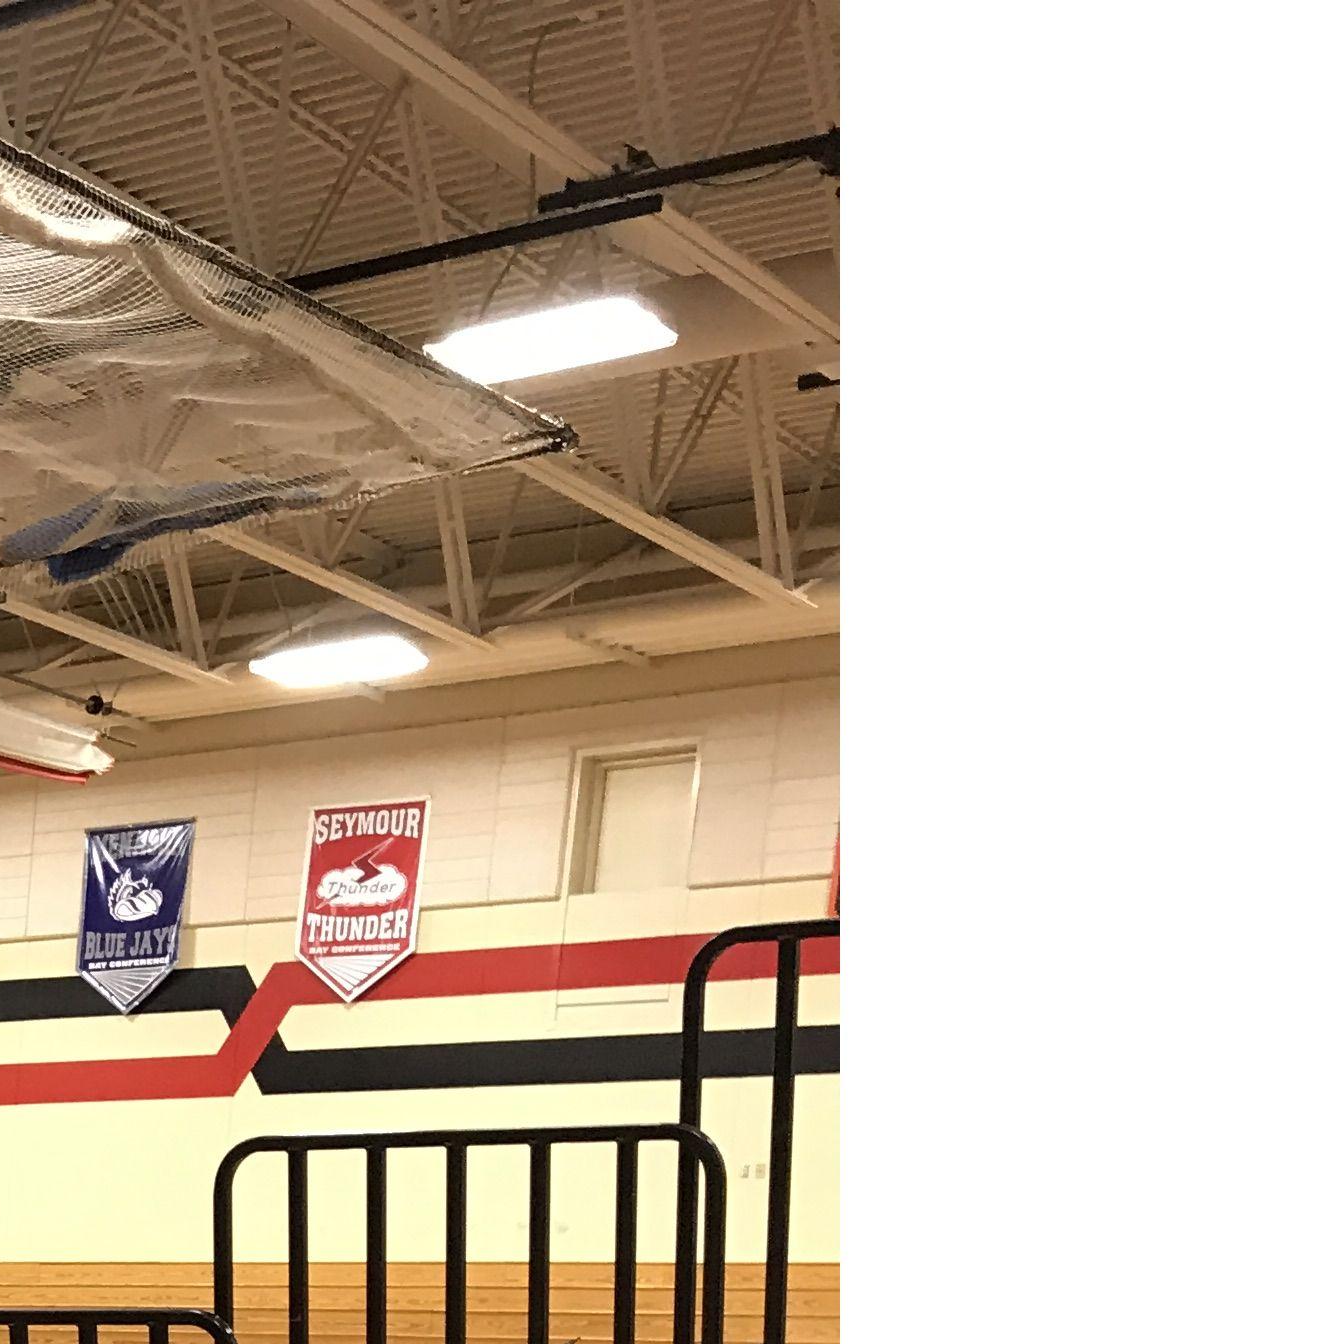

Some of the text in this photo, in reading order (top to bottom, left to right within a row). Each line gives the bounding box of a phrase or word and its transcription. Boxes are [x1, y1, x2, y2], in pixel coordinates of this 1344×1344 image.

[315, 808, 421, 845] SEYMOUR
[327, 880, 396, 894] Thunder
[307, 908, 409, 943] THUNDER
[84, 931, 127, 960] BLUE
[88, 961, 107, 970] BAY
